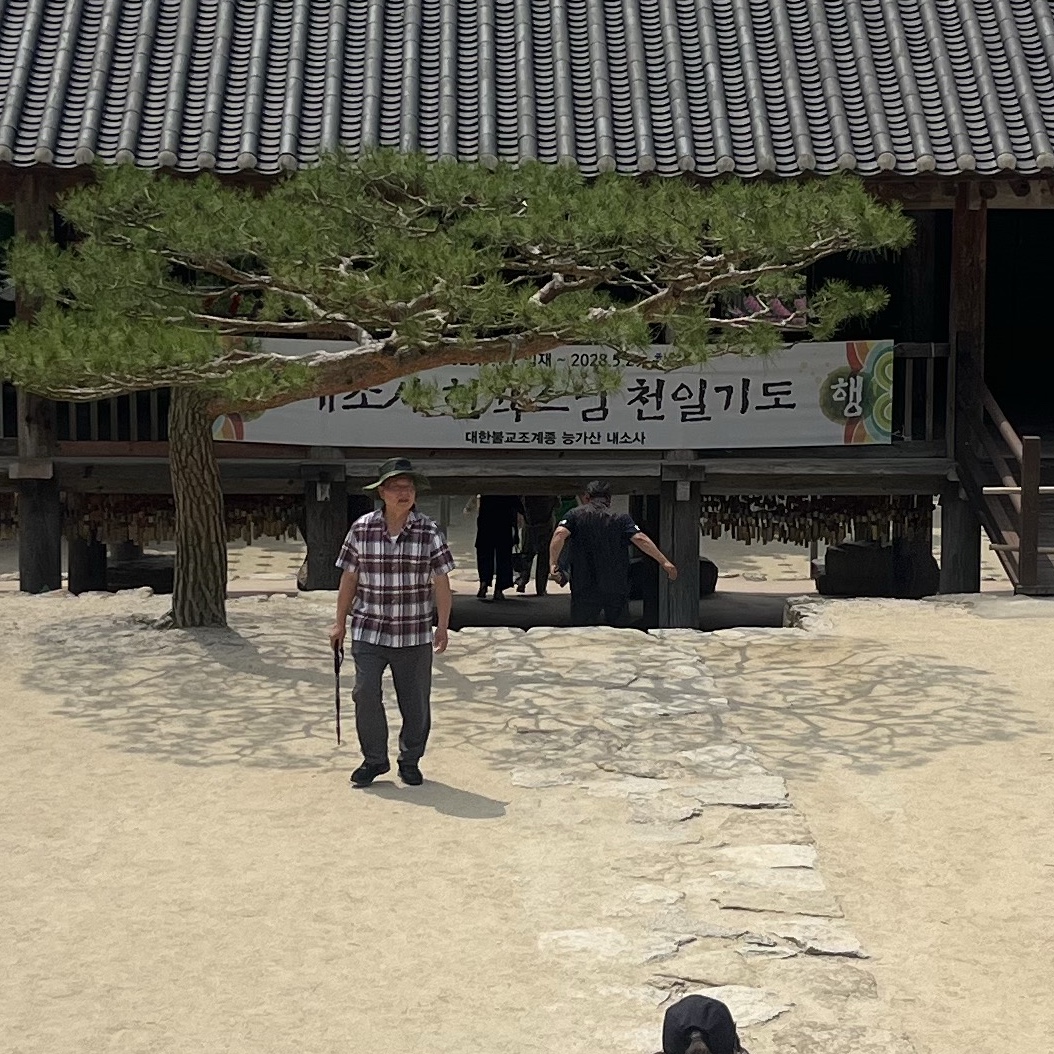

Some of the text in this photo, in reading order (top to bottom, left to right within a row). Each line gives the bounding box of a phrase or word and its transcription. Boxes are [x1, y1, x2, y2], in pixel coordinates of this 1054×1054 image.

[626, 377, 797, 423] 천일기도
[830, 375, 864, 417] 행
[465, 431, 646, 445] 대한불교조계종 능가산 내소사
